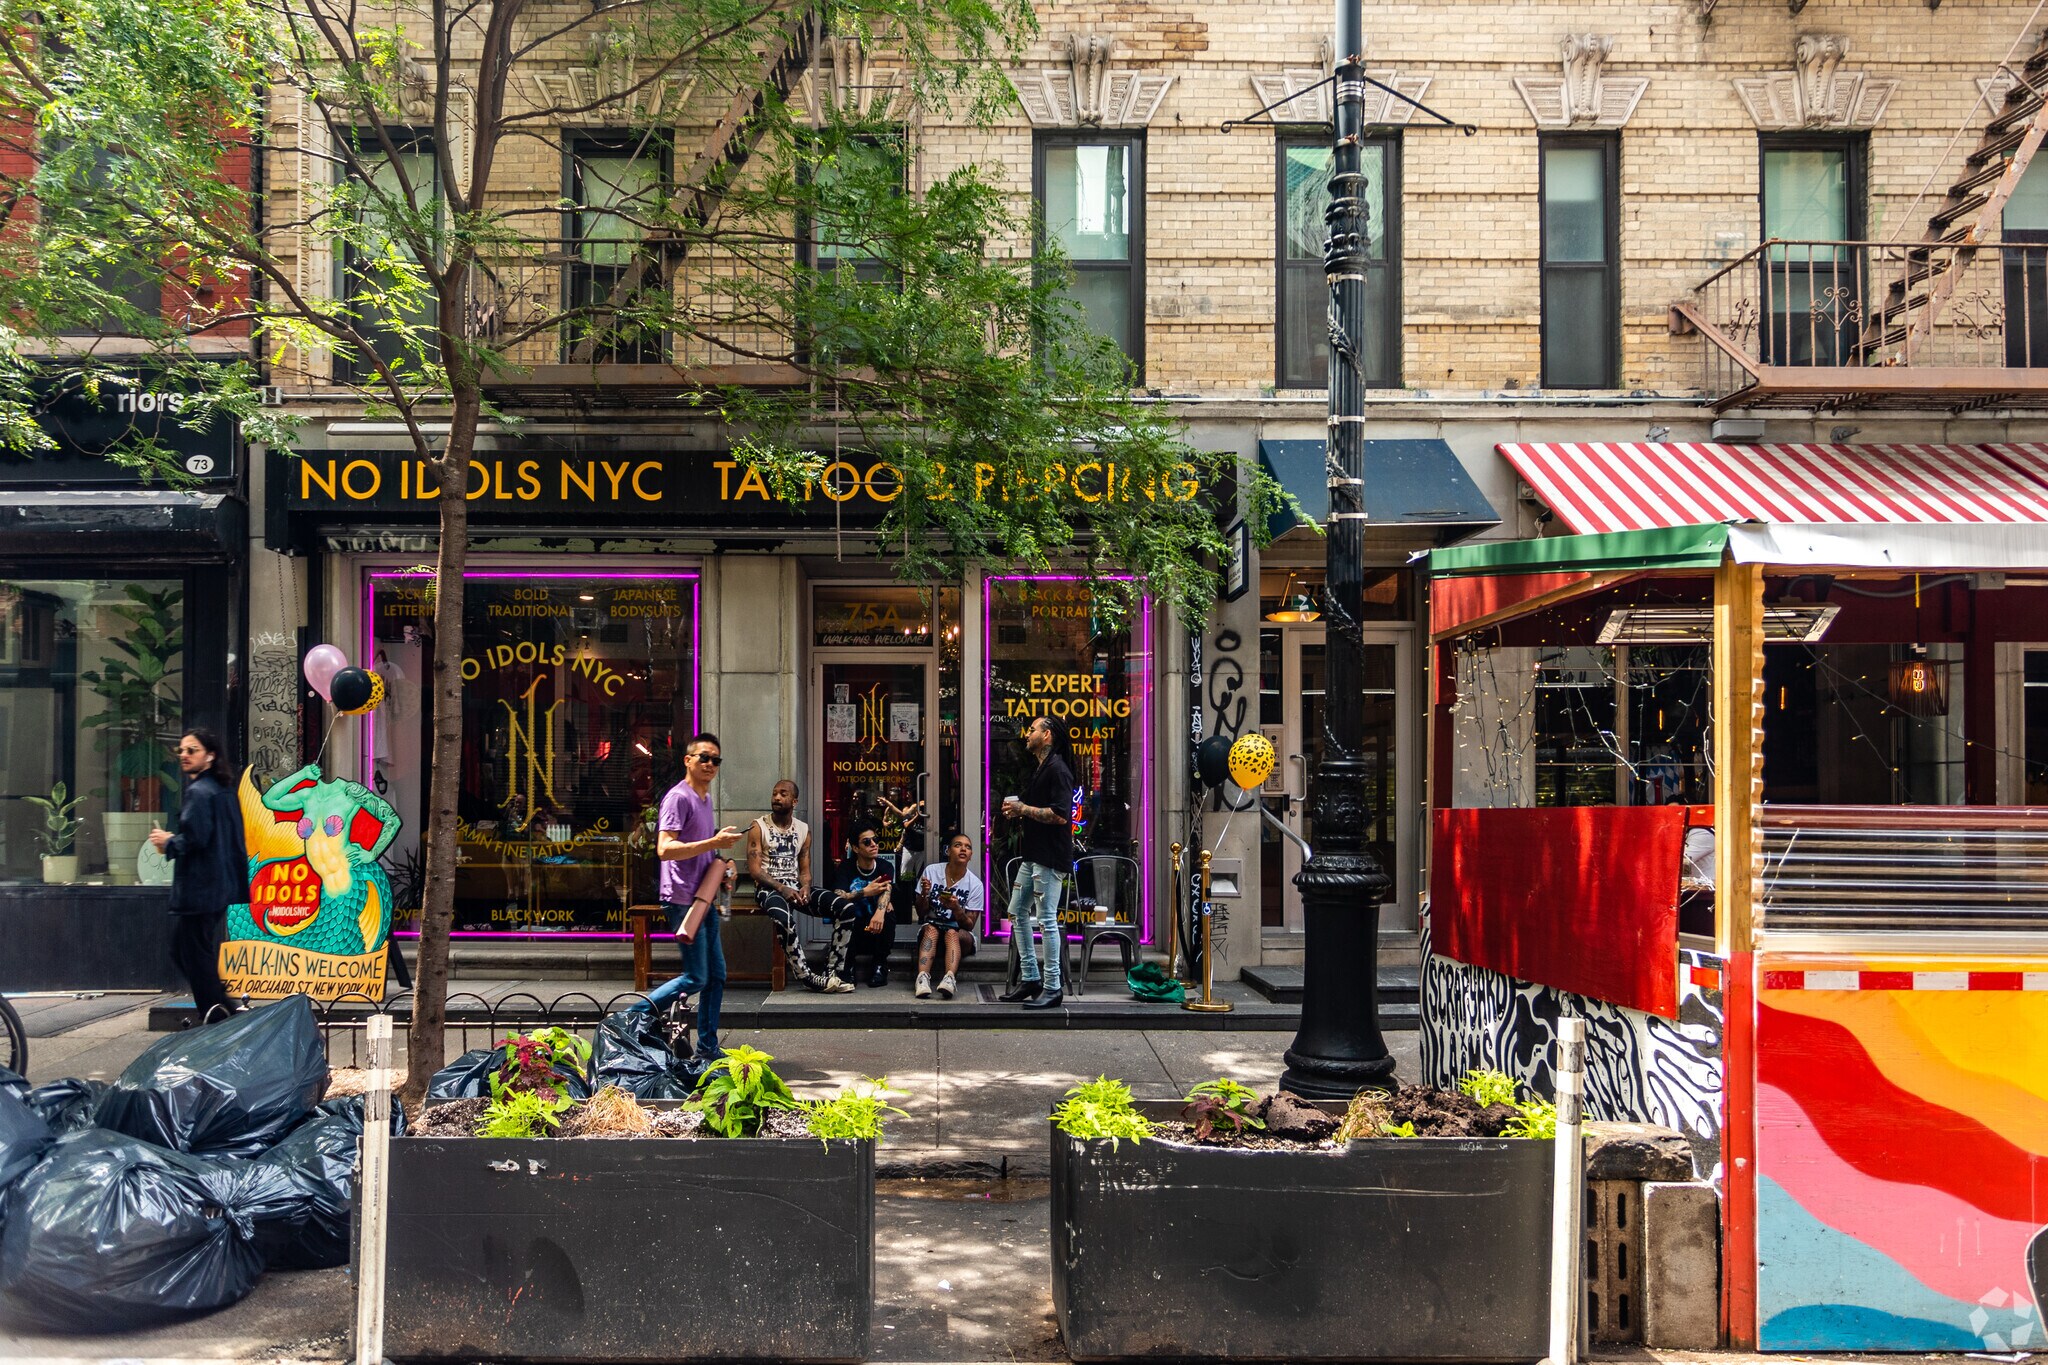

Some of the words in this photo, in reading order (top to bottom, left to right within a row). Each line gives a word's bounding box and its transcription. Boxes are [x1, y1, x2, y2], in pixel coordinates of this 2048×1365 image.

[193, 459, 208, 470] 73
[301, 459, 382, 500] NO
[401, 459, 542, 501] IDOLS
[560, 459, 663, 502] NYC
[513, 588, 549, 601] BOLD
[612, 588, 677, 602] JAPANESE
[1020, 589, 1062, 602] BACK
[384, 604, 437, 617] LETTERI
[488, 604, 575, 617] TRADITIONAL
[610, 604, 682, 618] BODYSUITS
[844, 602, 902, 631] 75A
[1031, 605, 1102, 618] PORTRAIS
[822, 634, 871, 645] WALK-INS
[874, 634, 928, 645] WELCOME!
[486, 641, 567, 671] IDOLS
[571, 650, 625, 697] NYC
[1030, 673, 1104, 693] EXPERT
[1004, 698, 1131, 718] TATTOOING
[1084, 727, 1115, 739] LAST
[1072, 743, 1102, 755] TIME
[833, 761, 852, 772] NO
[855, 761, 888, 772] IDOLS
[890, 761, 915, 772] NYC
[836, 775, 867, 784] TATTOO
[876, 775, 911, 784] PIERCING
[456, 815, 493, 850] DAMN
[494, 842, 528, 859] FINE
[530, 816, 610, 859] TATTOOING
[272, 863, 309, 884] NO
[254, 884, 318, 905] IDOLS
[491, 909, 575, 922] BLACKWORK
[223, 945, 301, 977] WALK-INS
[304, 954, 384, 980] WELCOME
[244, 979, 295, 995] ORCHARD
[311, 981, 337, 995] NEW
[366, 983, 382, 997] NY
[1428, 957, 1508, 1032] SCRAPYARD
